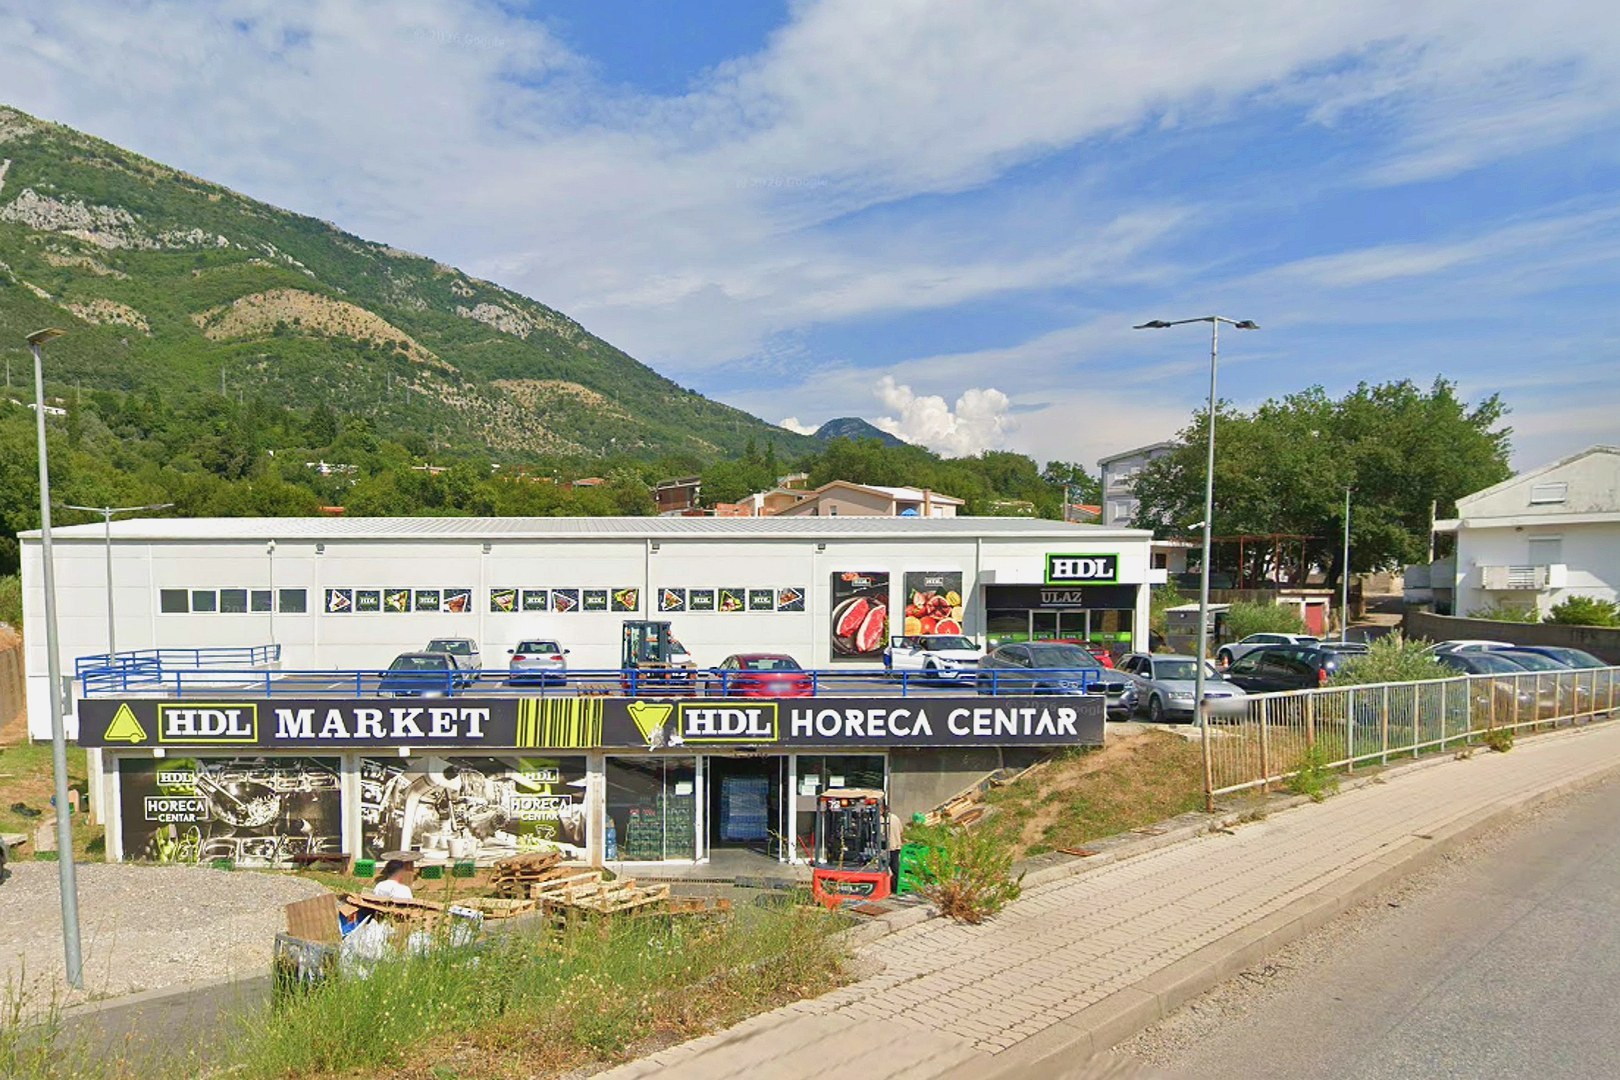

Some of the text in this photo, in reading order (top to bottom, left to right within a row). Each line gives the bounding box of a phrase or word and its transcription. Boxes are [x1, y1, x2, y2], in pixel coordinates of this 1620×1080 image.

[1051, 558, 1114, 578] HDL
[1040, 591, 1083, 603] ULAZ
[165, 708, 490, 738] HDL MARKET
[685, 708, 1078, 737] HDL HORECA CENTAR
[160, 772, 193, 783] HDL
[523, 771, 556, 781] HDL
[147, 800, 205, 812] HORECA
[511, 797, 568, 811] HORECA
[158, 813, 196, 823] CENTAR
